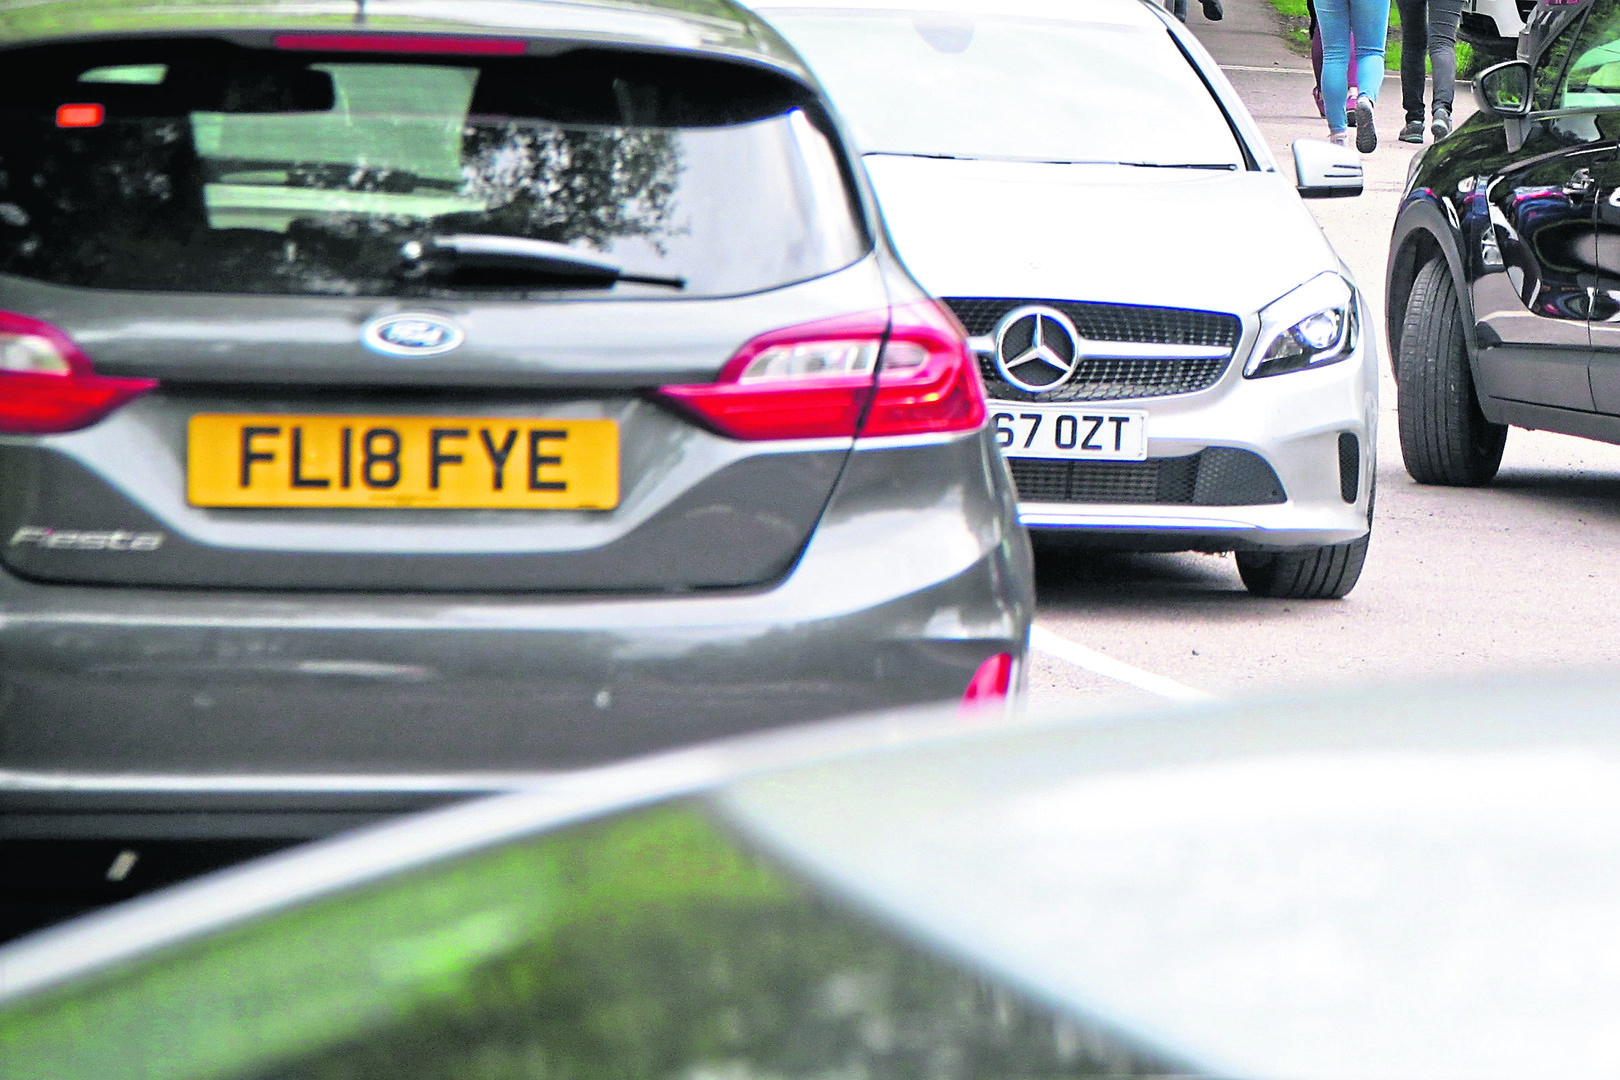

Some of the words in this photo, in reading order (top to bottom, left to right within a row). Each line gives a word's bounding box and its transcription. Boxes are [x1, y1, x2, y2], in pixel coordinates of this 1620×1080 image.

[1055, 414, 1130, 451] OZT
[238, 426, 402, 490] FL18
[428, 428, 568, 491] FYE
[9, 525, 164, 551] Fiesta
